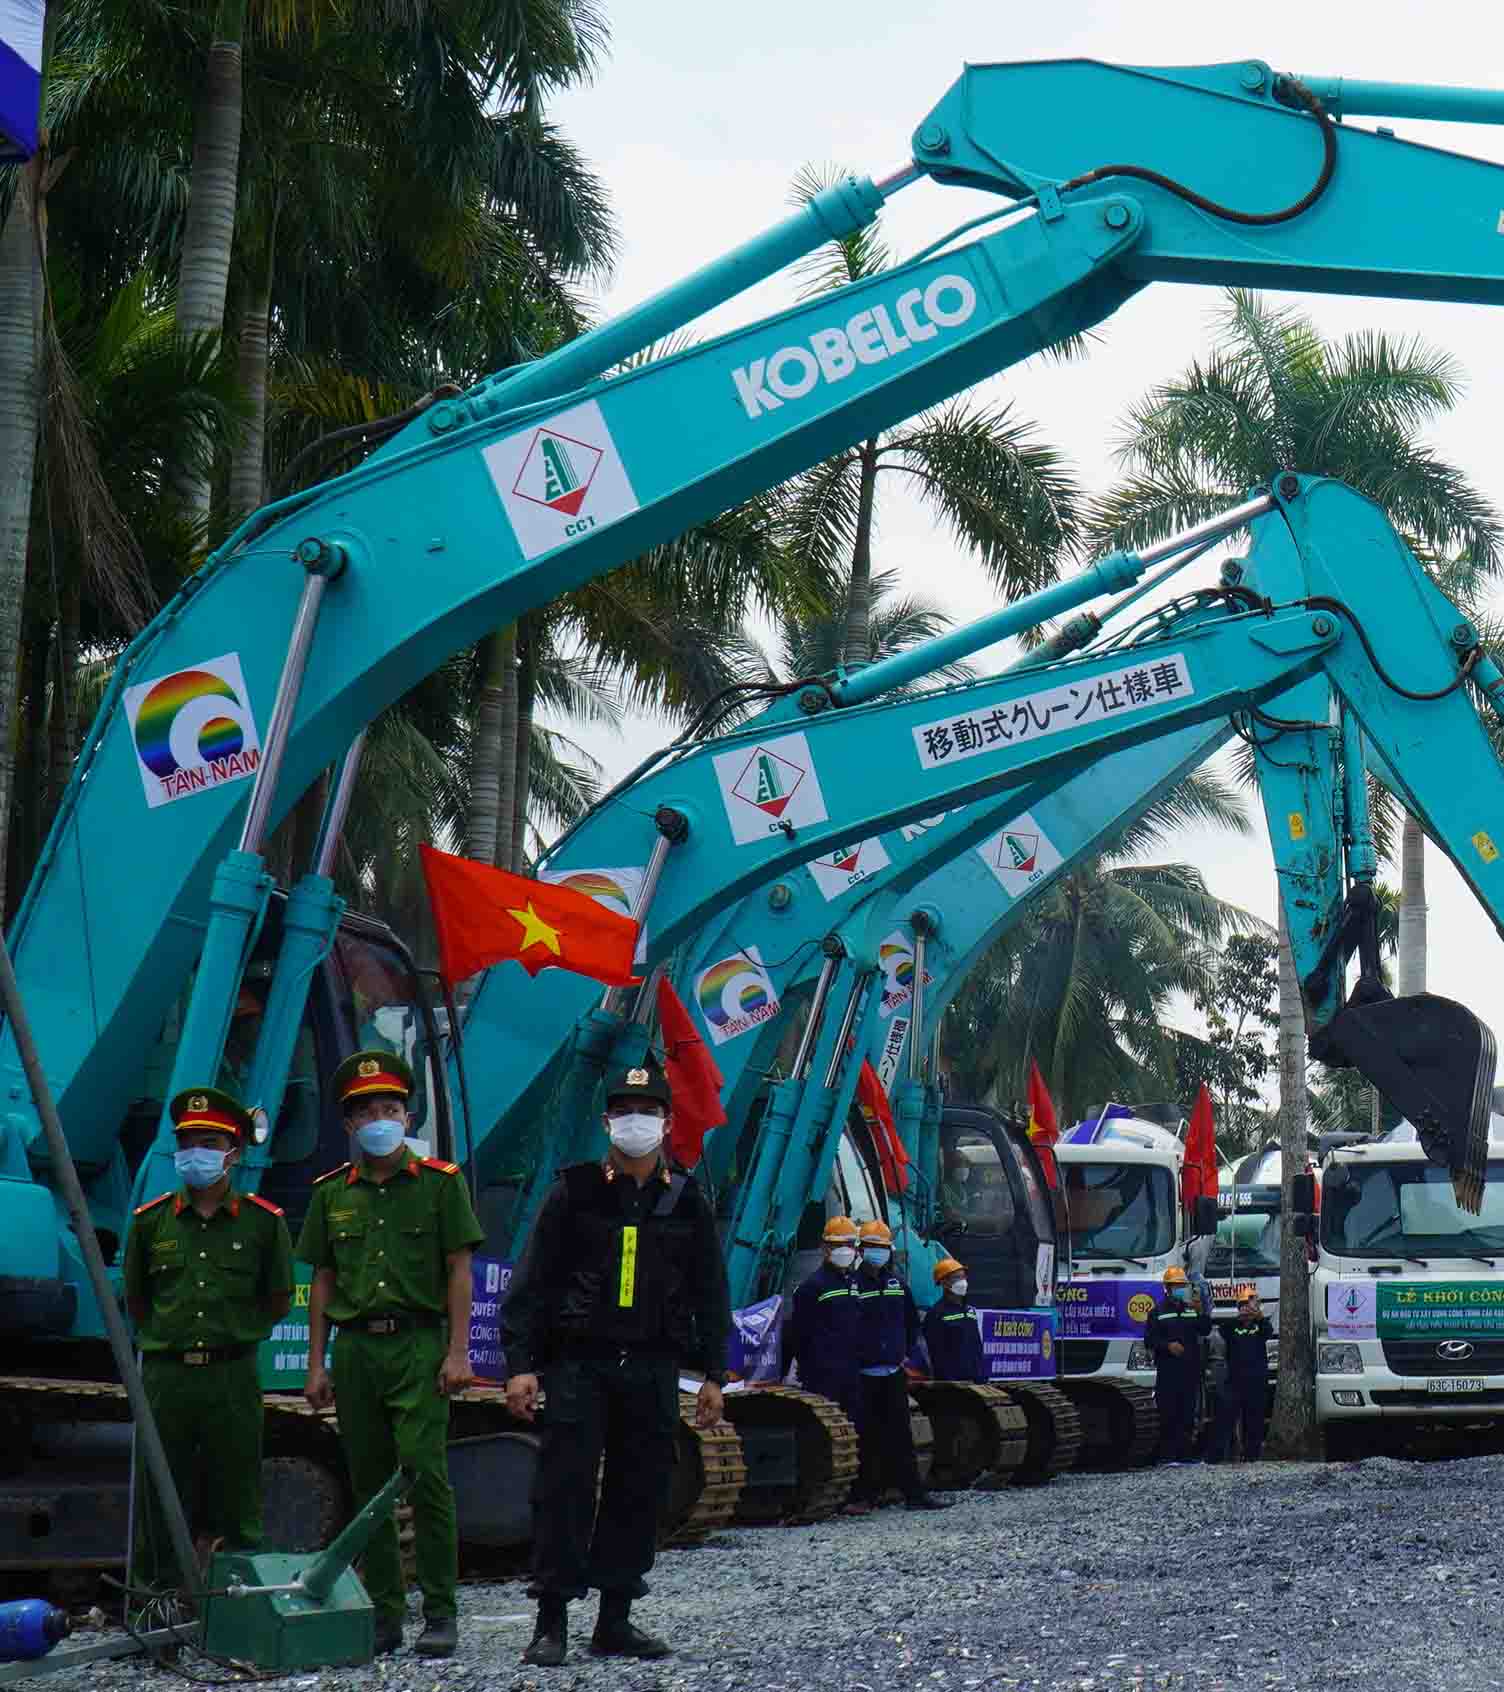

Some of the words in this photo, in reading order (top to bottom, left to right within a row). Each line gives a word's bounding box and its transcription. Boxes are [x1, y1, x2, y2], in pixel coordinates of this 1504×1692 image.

[731, 274, 977, 419] KOBELCO
[564, 515, 597, 537] CC1
[1396, 1287, 1417, 1303] LỄ
[1424, 1287, 1464, 1303] KHỞI
